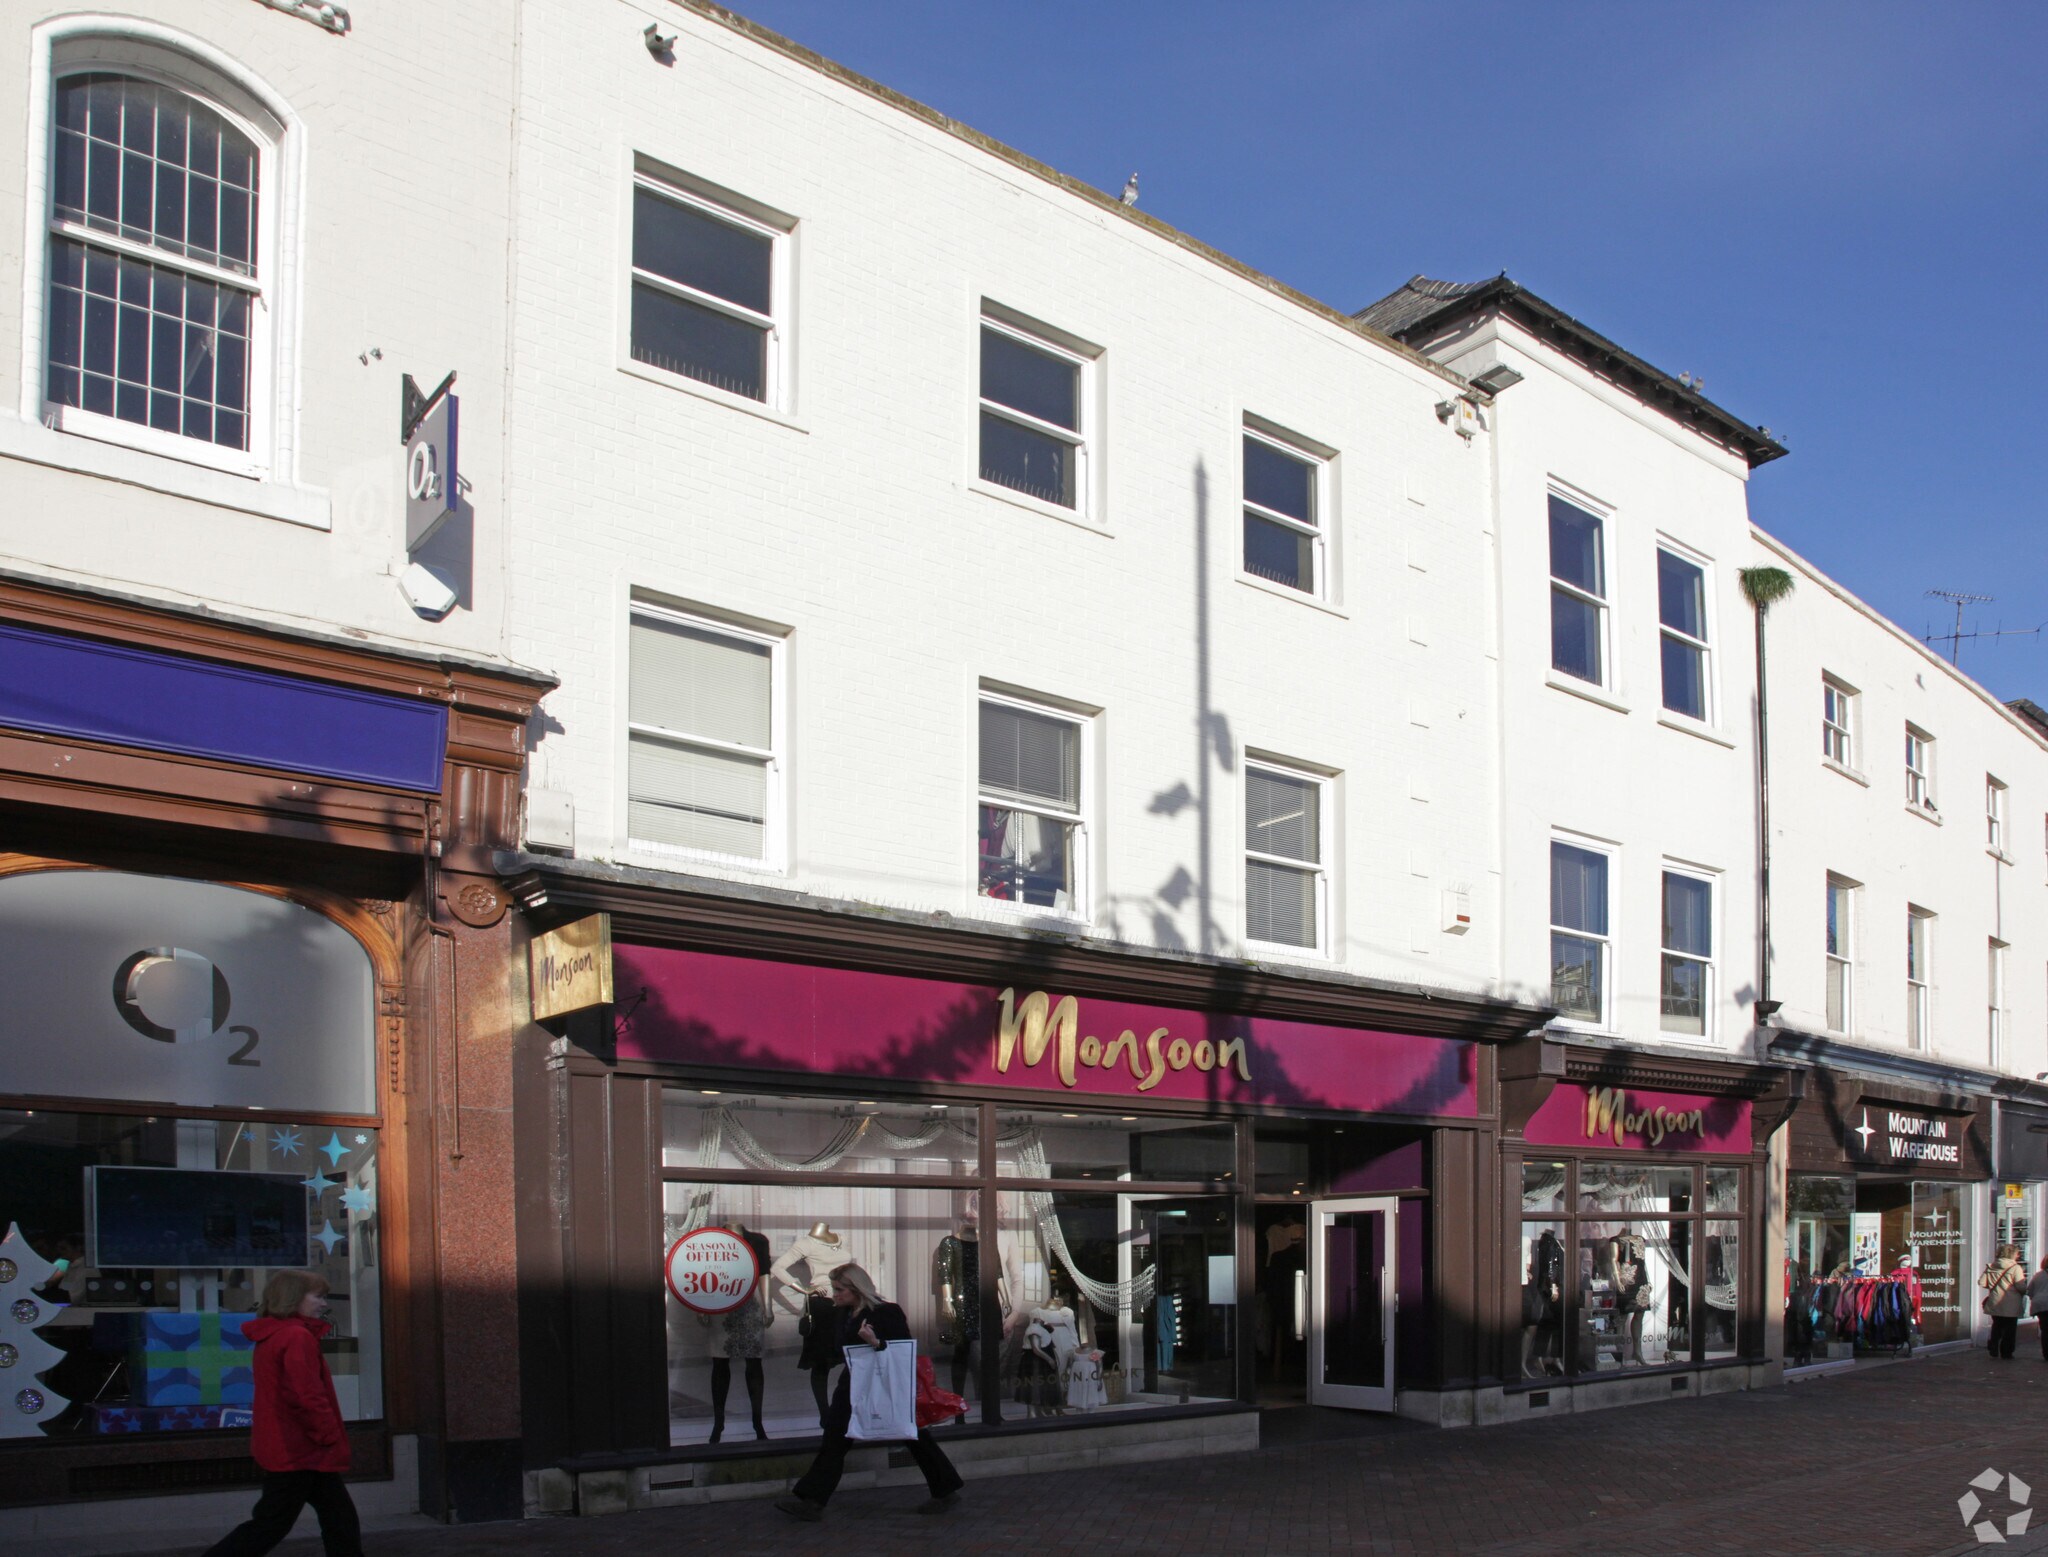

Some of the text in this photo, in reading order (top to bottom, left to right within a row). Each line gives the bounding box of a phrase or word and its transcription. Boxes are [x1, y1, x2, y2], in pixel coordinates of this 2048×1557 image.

[408, 441, 438, 499] O2
[541, 952, 593, 992] Monsoon
[112, 946, 261, 1067] O2
[997, 987, 1252, 1092] Monsoon
[1587, 1085, 1705, 1146] Monsoon
[1888, 1112, 1947, 1138] MOUNTAIN
[1889, 1137, 1959, 1162] WAREHOUSE
[686, 1242, 739, 1251] SEASONAL
[686, 1251, 740, 1262] OFFERS
[1924, 1263, 1951, 1271] travel
[719, 1279, 746, 1296] off
[1921, 1290, 1950, 1300] hiking
[1000, 1369, 1138, 1388] MONSOON.COUK
